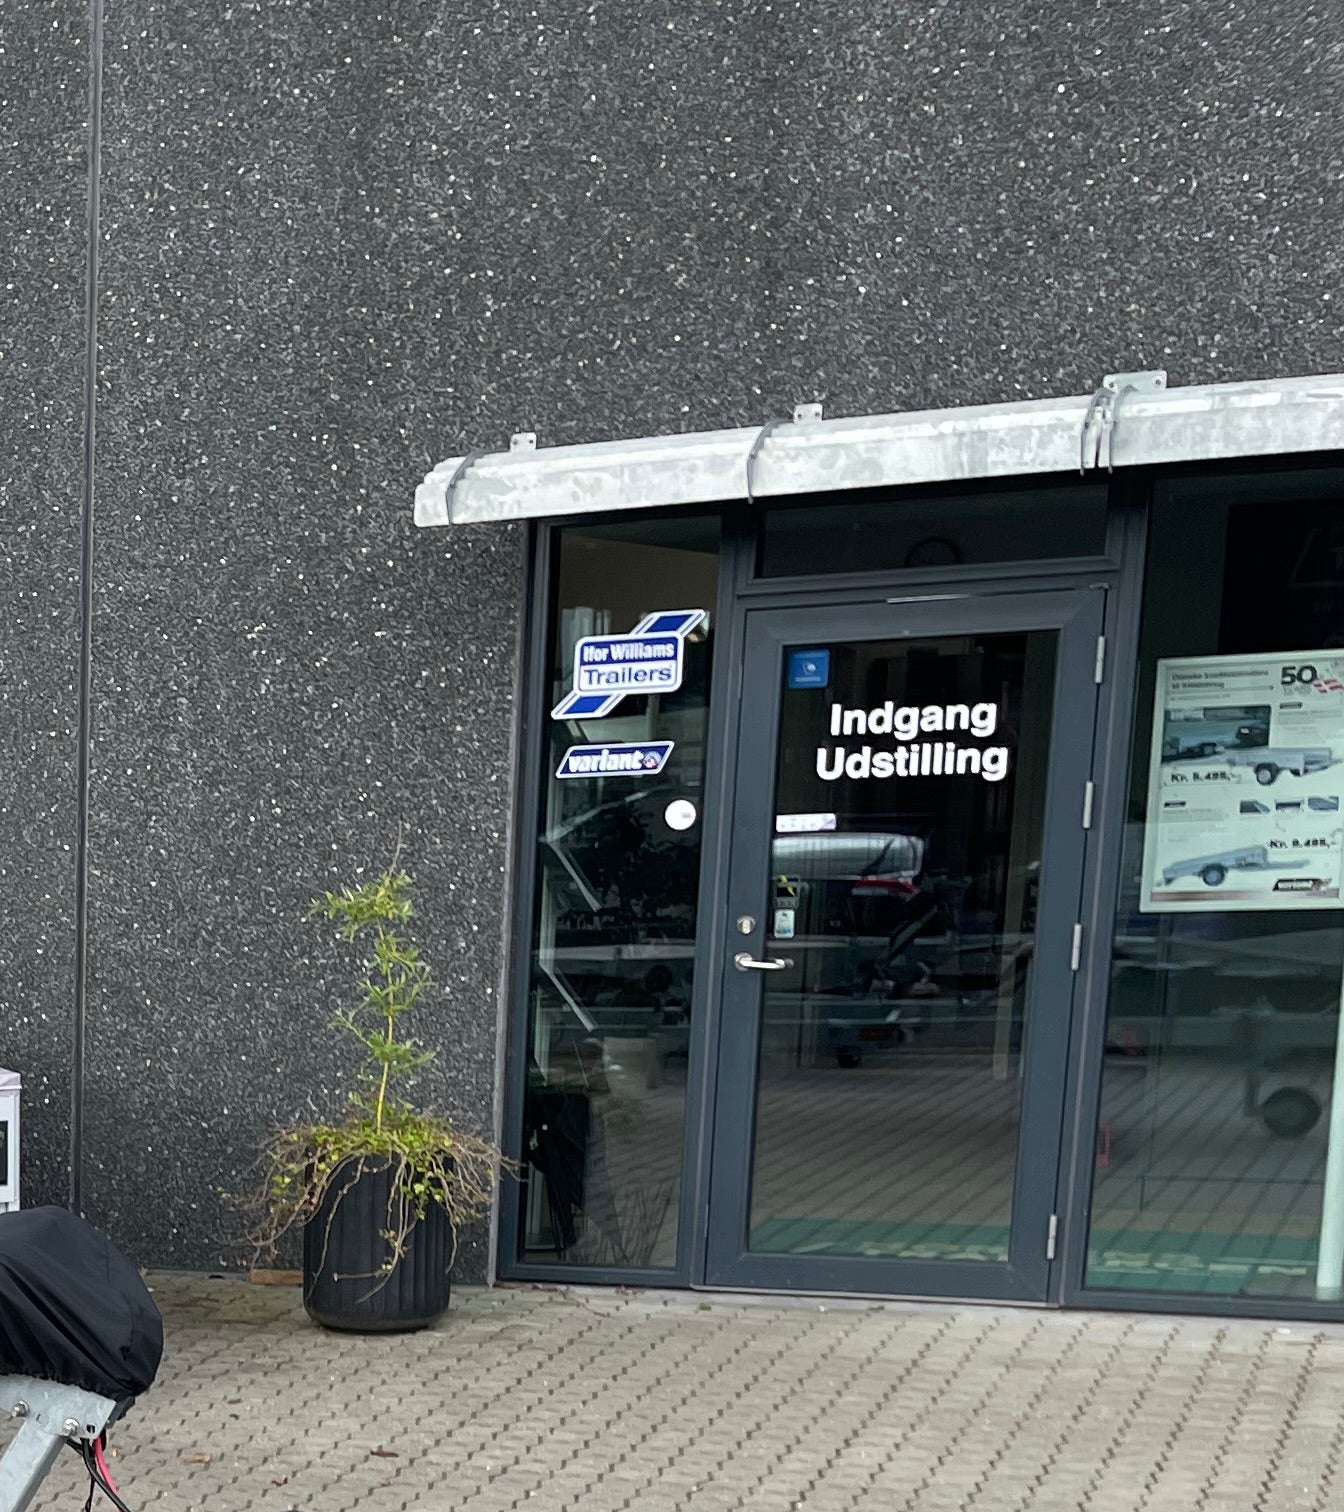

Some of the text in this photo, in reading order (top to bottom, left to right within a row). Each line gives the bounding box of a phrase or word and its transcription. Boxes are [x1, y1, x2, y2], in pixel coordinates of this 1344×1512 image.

[582, 642, 675, 662] Ifor Williams
[583, 666, 672, 685] Trailers
[1281, 664, 1318, 686] 50
[830, 701, 998, 741] Indgang
[568, 748, 644, 772] variant
[816, 742, 1009, 782] Udstilling
